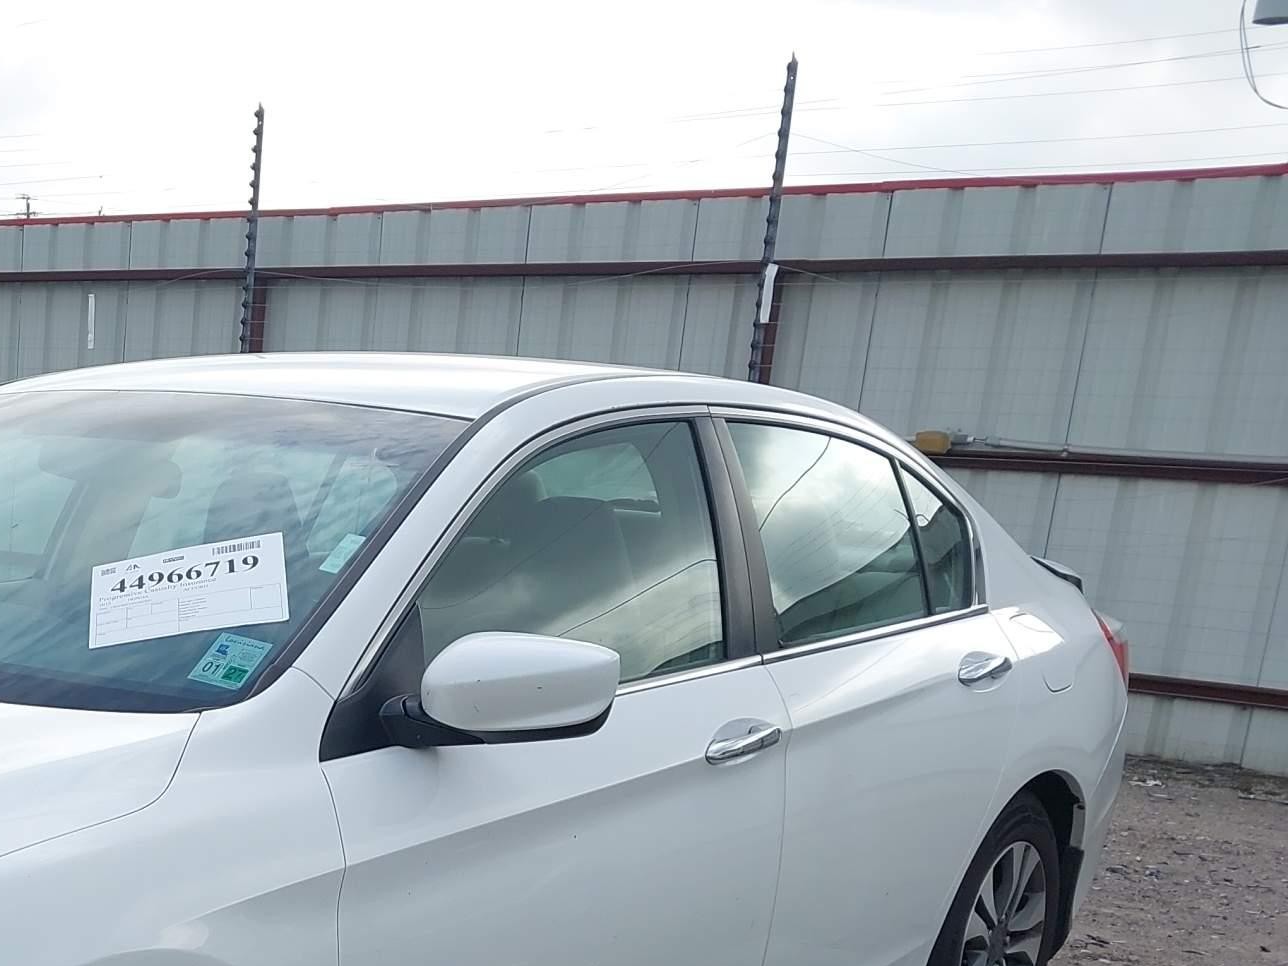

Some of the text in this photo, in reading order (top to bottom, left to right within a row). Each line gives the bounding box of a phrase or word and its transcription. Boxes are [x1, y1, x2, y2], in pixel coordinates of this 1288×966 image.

[110, 554, 260, 594] 44966719
[202, 661, 221, 675] 01
[226, 666, 249, 682] 27
